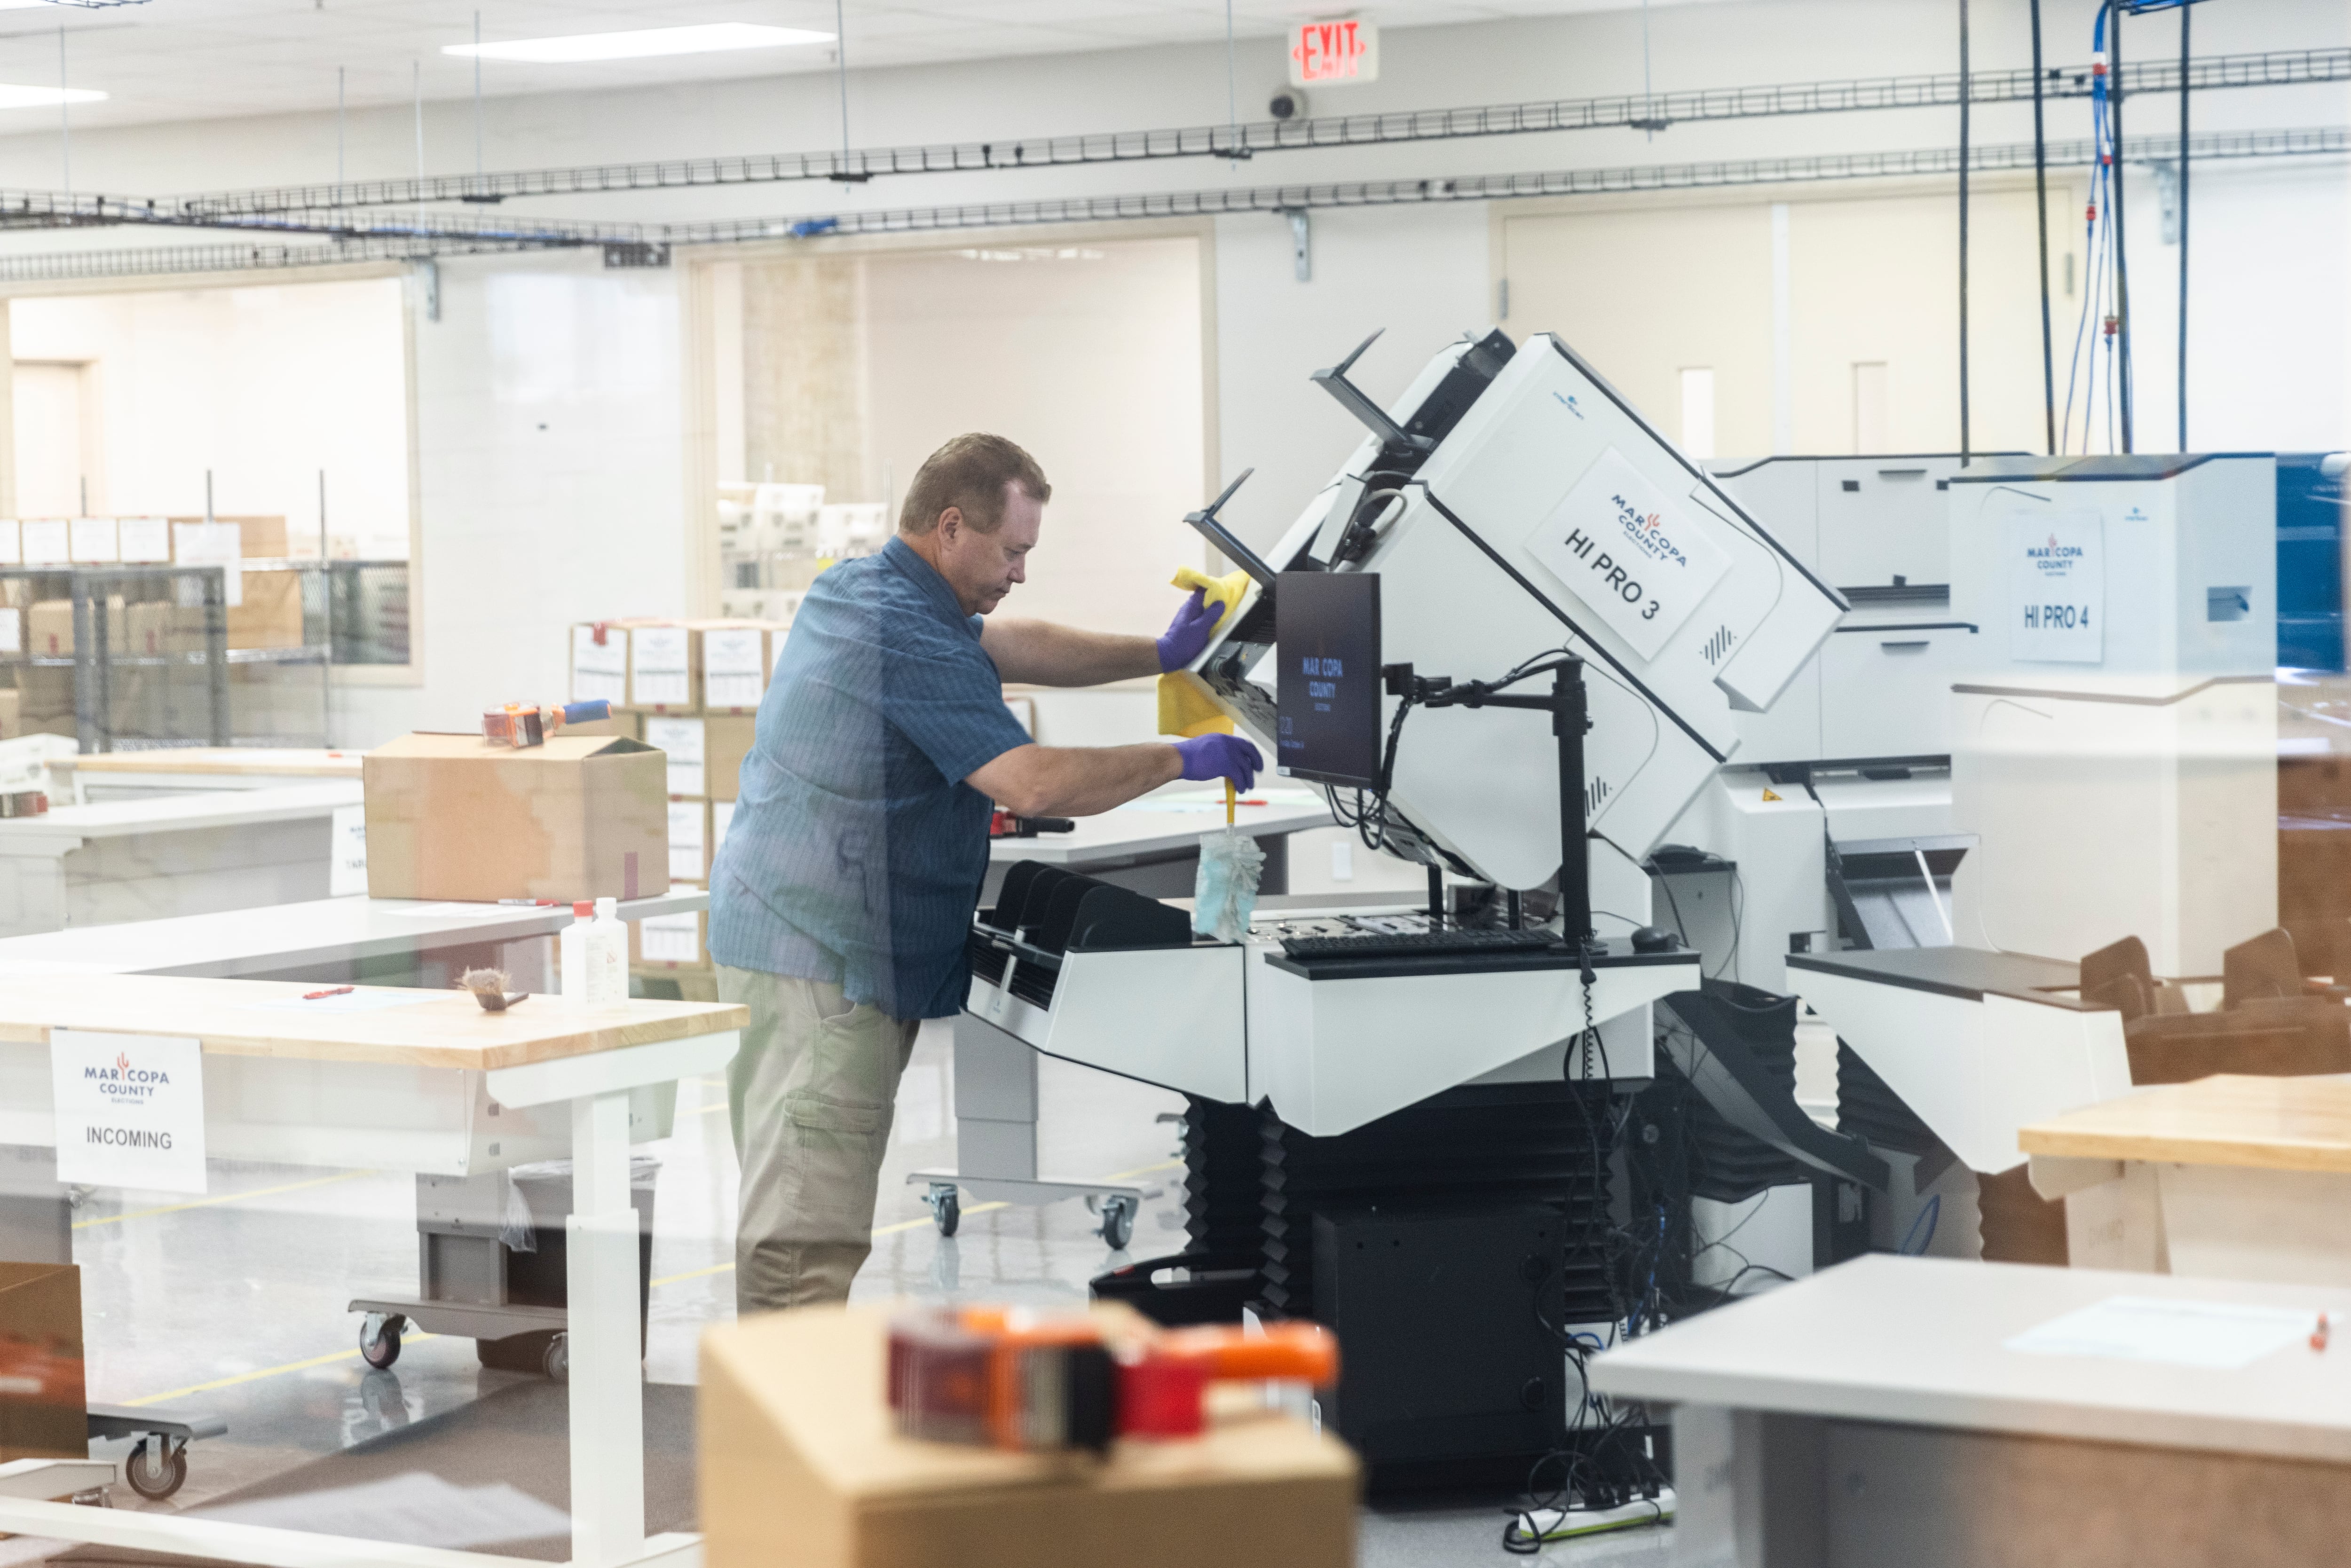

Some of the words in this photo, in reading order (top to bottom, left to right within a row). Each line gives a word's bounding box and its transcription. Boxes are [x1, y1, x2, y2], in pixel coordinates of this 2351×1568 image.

[1301, 22, 1359, 79] EXIT
[1612, 494, 1687, 567] MARICOPA
[1618, 514, 1668, 560] COUNTY
[1564, 528, 1594, 559] HI
[1591, 552, 1642, 602] PRO
[1642, 600, 1660, 619] 3
[2037, 560, 2073, 569] COUNTY
[2024, 605, 2039, 628] HI
[2044, 605, 2075, 629] PRO
[2080, 605, 2089, 628] 4
[84, 1052, 169, 1084] MARICOPA
[99, 1083, 155, 1097] COUNTY
[87, 1126, 172, 1150] INCOMING
